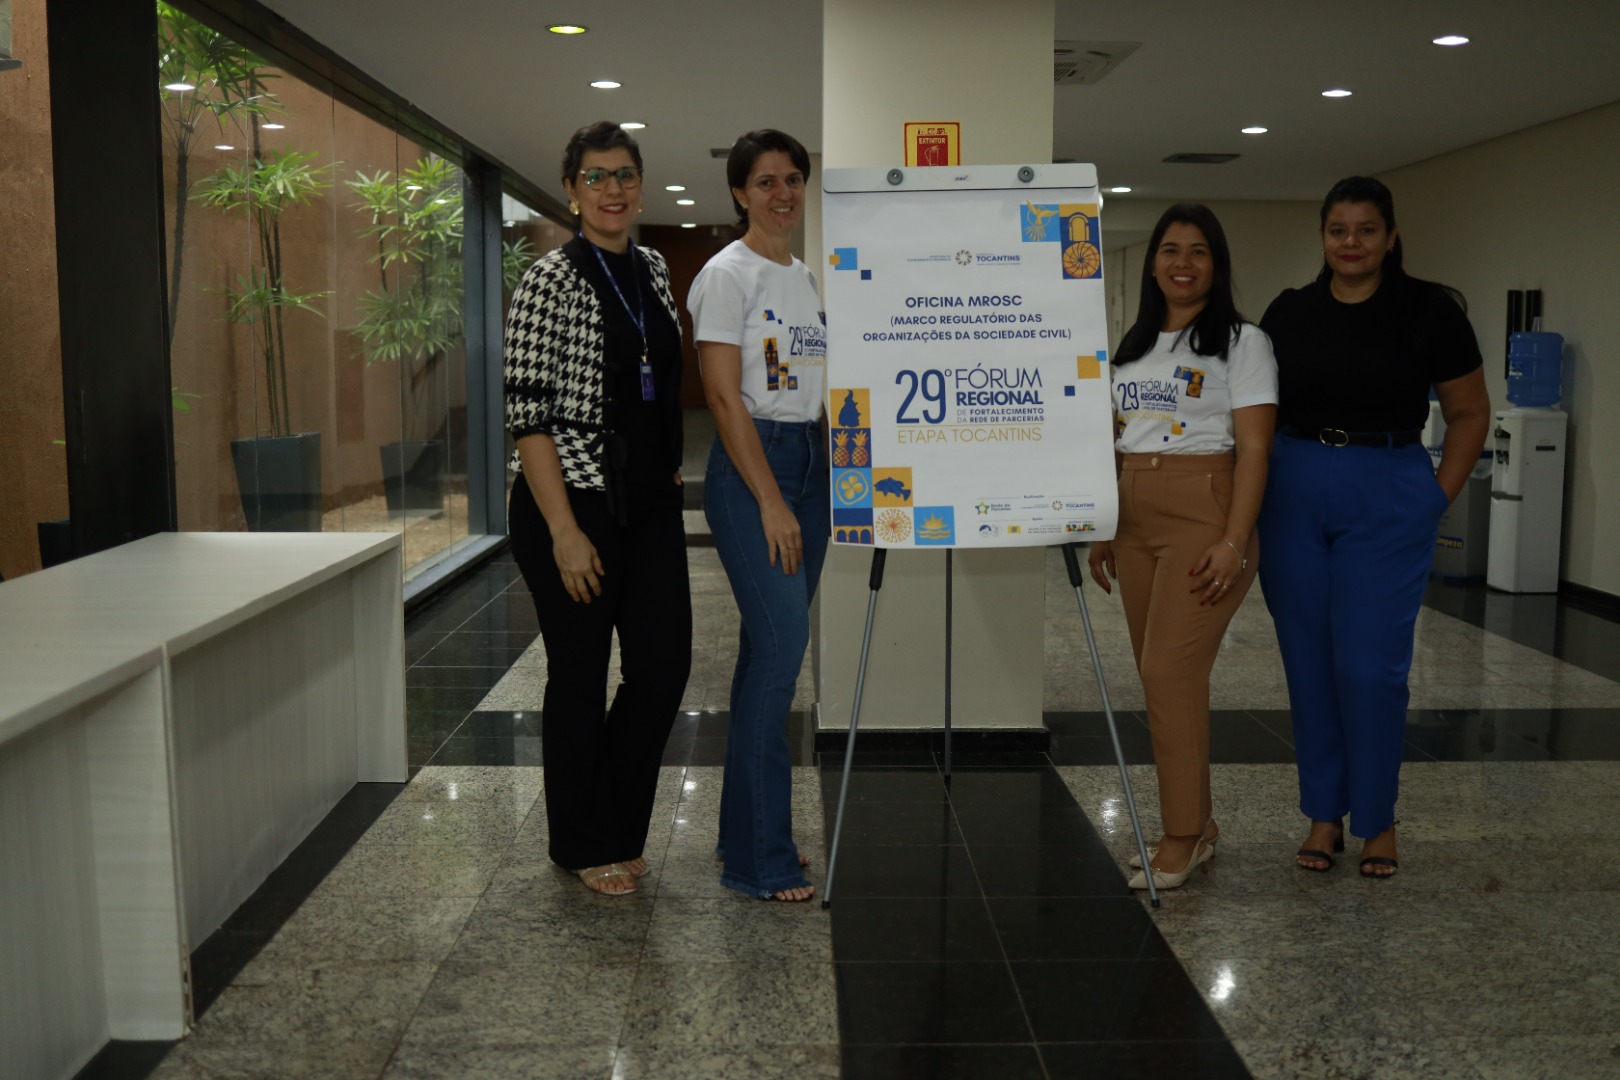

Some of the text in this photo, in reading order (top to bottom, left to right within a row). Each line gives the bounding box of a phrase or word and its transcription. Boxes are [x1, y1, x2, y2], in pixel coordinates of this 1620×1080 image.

[976, 254, 1020, 263] TOCANTINS
[905, 295, 1022, 308] OFICINA MROSC
[890, 312, 1042, 327] (MARCO REGULATÓRIO DAS
[862, 328, 1071, 343] ORGANIZAÇÕES DA SOCIEDADE CIVIL)
[955, 362, 1043, 389] FÓRUM
[1140, 377, 1179, 395] FÓRUM
[956, 390, 1044, 406] REGIONAL
[1140, 392, 1177, 404] REGIONAL
[970, 407, 1044, 416] FORTALECIMENTO
[897, 427, 1042, 444] ETAPA TOCANTINS
